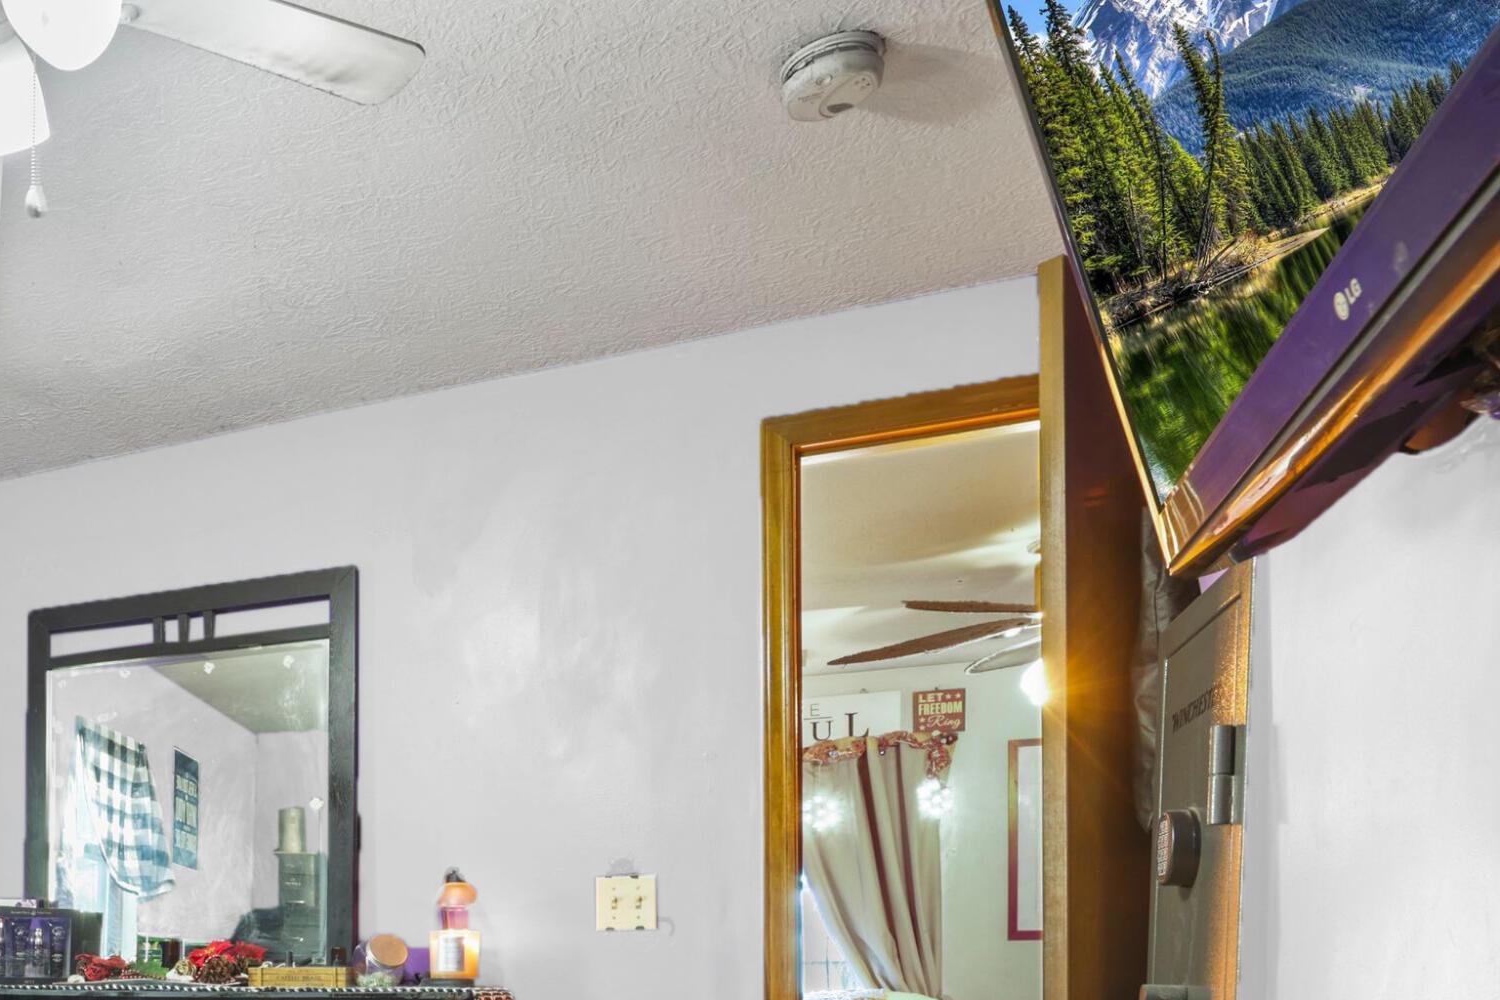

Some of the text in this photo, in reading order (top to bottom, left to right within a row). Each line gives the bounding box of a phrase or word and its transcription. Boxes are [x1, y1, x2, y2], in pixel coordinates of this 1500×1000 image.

[1344, 277, 1362, 304] LG
[919, 692, 944, 703] LET
[918, 701, 964, 716] FREEDOM
[1172, 684, 1219, 734] WINCHEST
[927, 715, 961, 729] Ring
